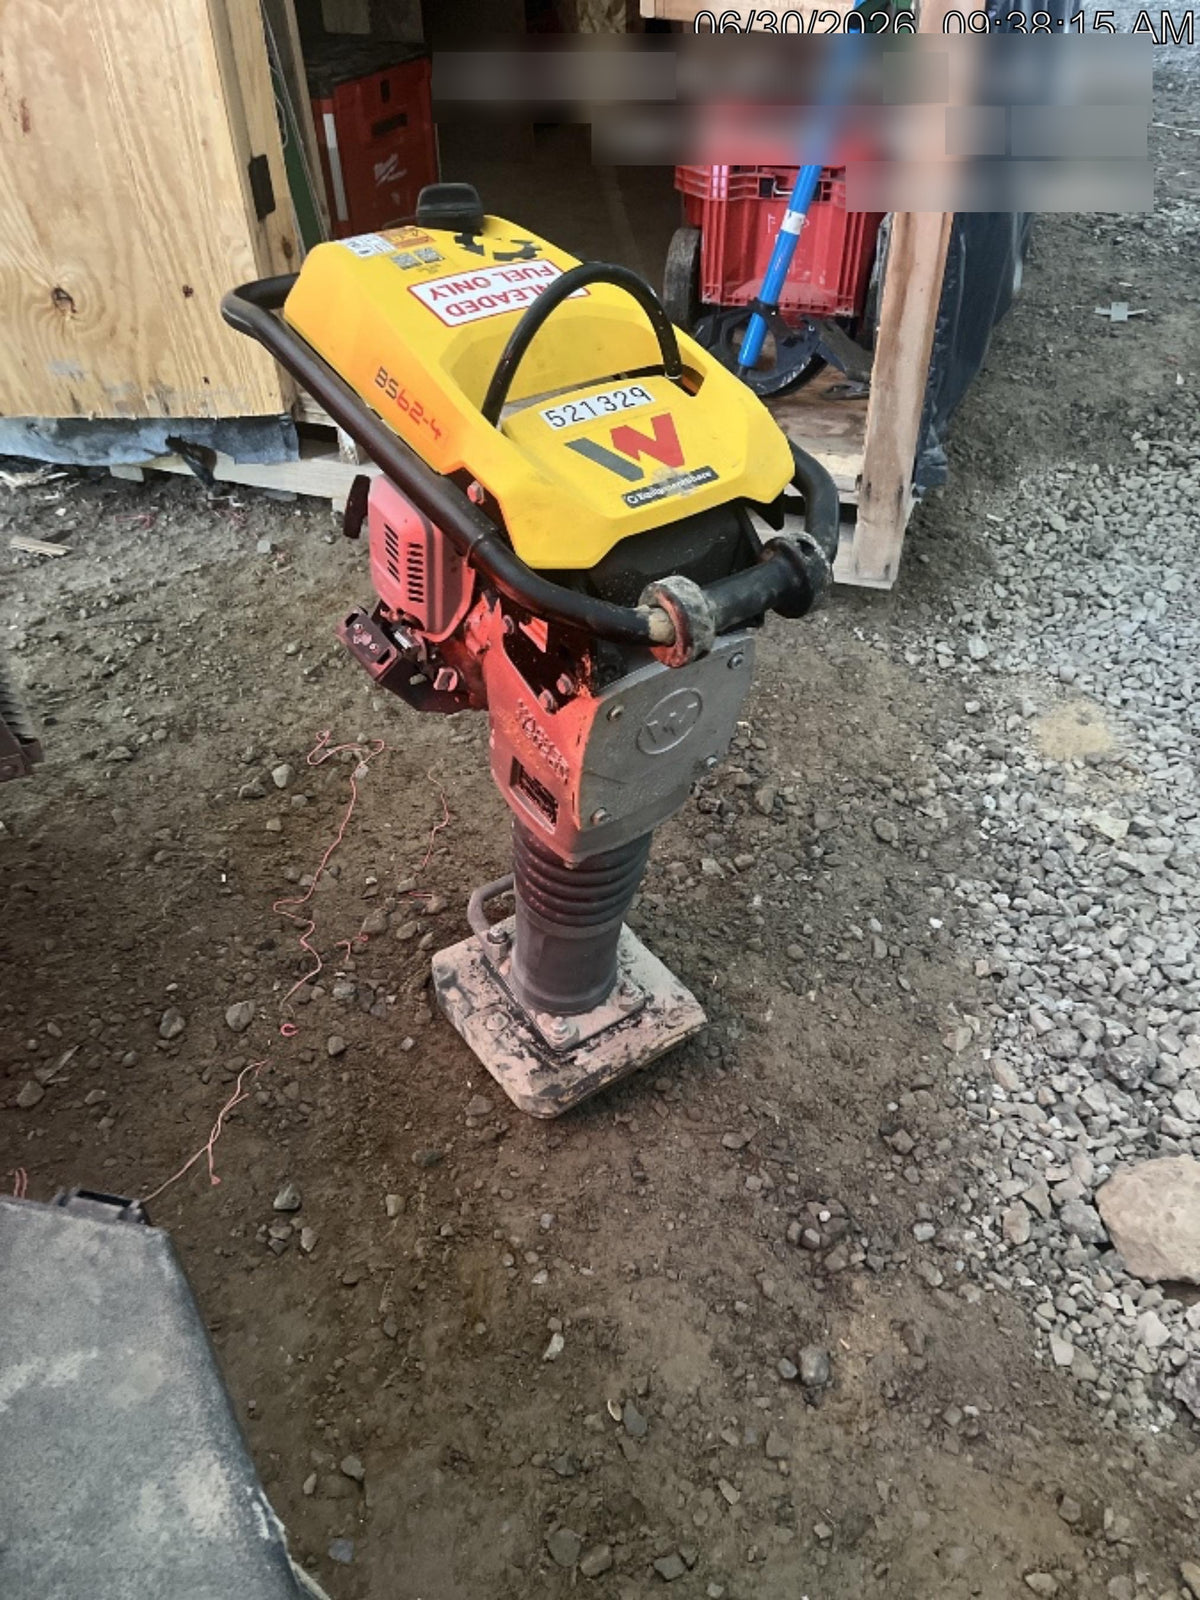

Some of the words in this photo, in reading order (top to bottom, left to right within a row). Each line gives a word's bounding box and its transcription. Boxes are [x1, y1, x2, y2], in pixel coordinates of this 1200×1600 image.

[429, 276, 492, 301] ONLY
[492, 264, 556, 283] FUEL
[445, 282, 549, 317] NLEADED
[545, 385, 652, 428] 521329
